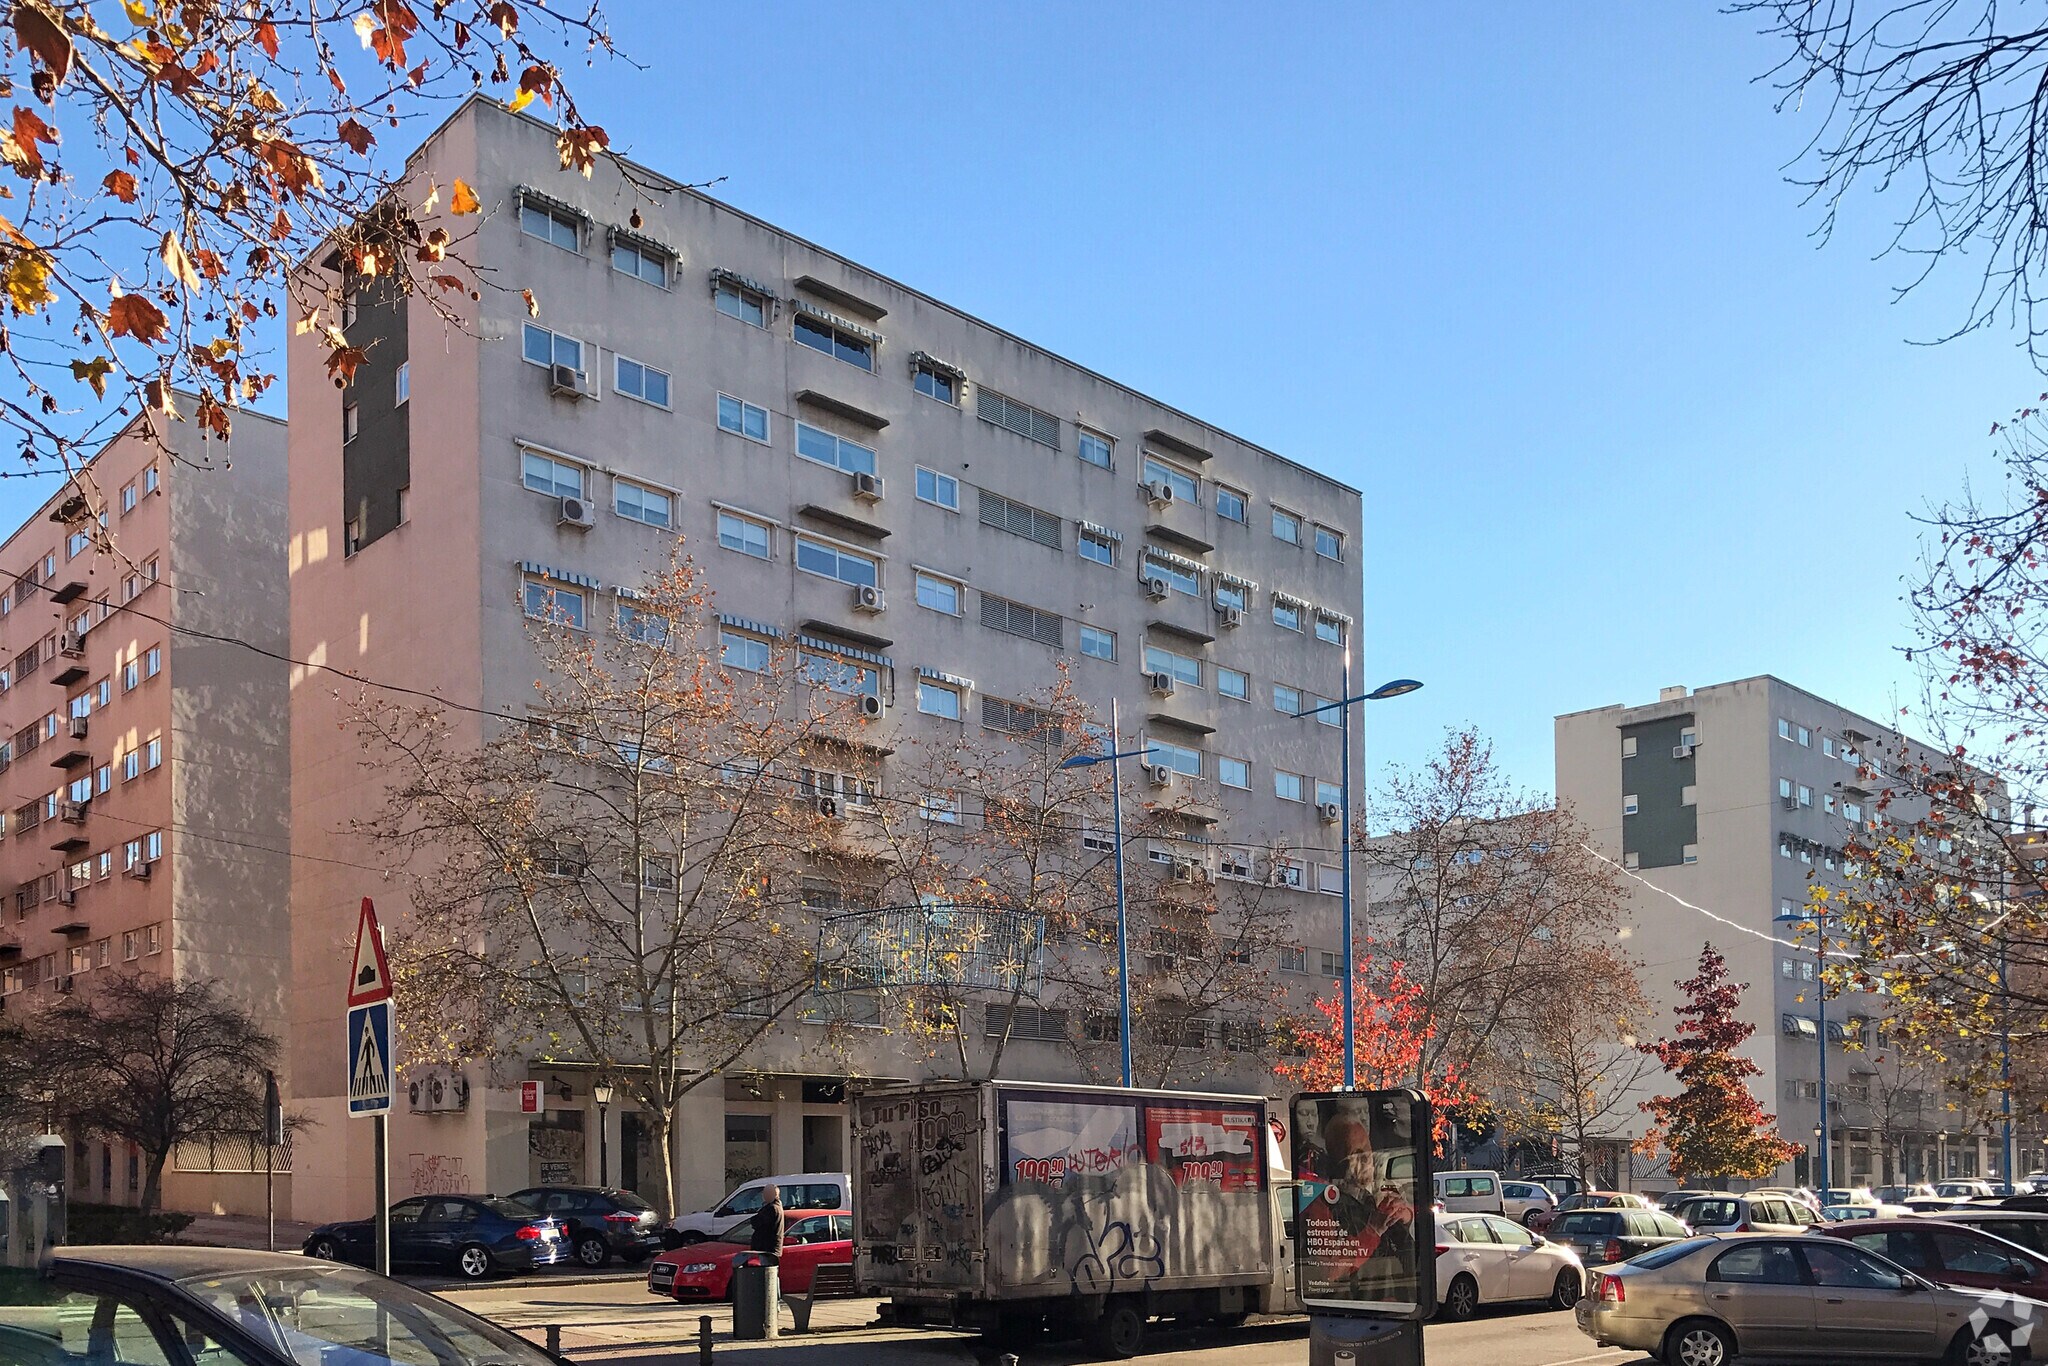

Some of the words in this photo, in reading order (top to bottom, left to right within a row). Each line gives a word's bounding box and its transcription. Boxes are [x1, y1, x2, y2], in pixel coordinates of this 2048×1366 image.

[872, 1106, 894, 1124] Tu
[1306, 1219, 1328, 1227] Todos
[1329, 1219, 1340, 1227] los
[1306, 1229, 1338, 1237] estrenos
[1339, 1228, 1348, 1237] de
[1307, 1238, 1322, 1246] HBO
[1324, 1238, 1350, 1247] España
[1307, 1247, 1341, 1256] Vodafone
[1342, 1248, 1358, 1256] One
[1358, 1248, 1369, 1256] TV
